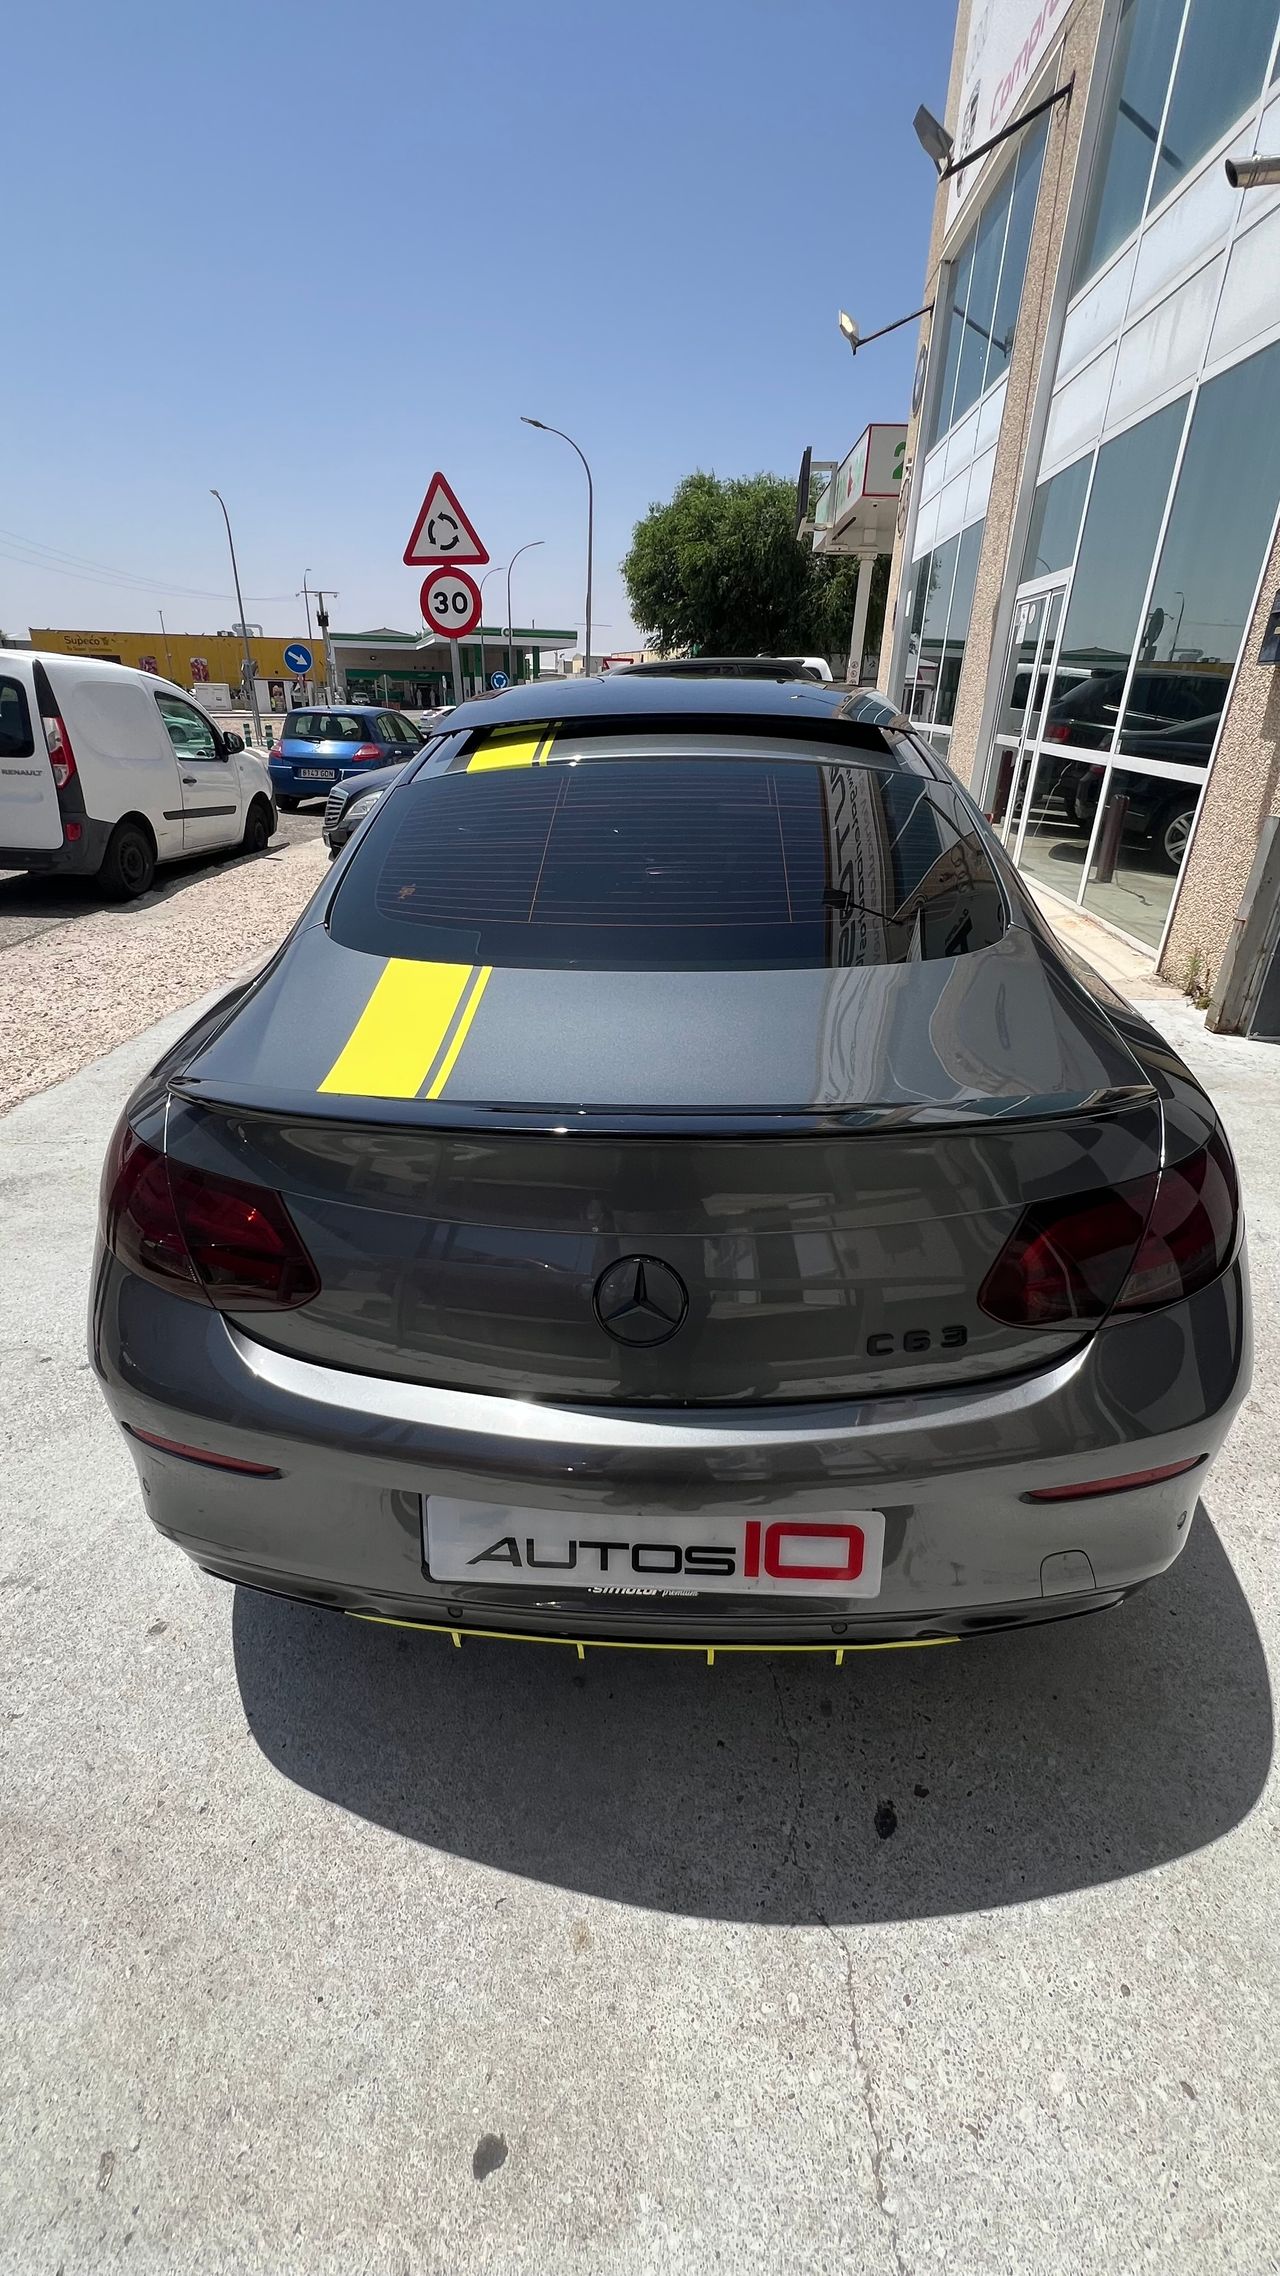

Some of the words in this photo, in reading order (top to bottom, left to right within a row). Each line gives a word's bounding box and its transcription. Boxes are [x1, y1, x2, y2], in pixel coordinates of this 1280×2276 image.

[433, 591, 468, 614] 30
[1, 768, 42, 776] RENAULT
[867, 1325, 967, 1356] C63
